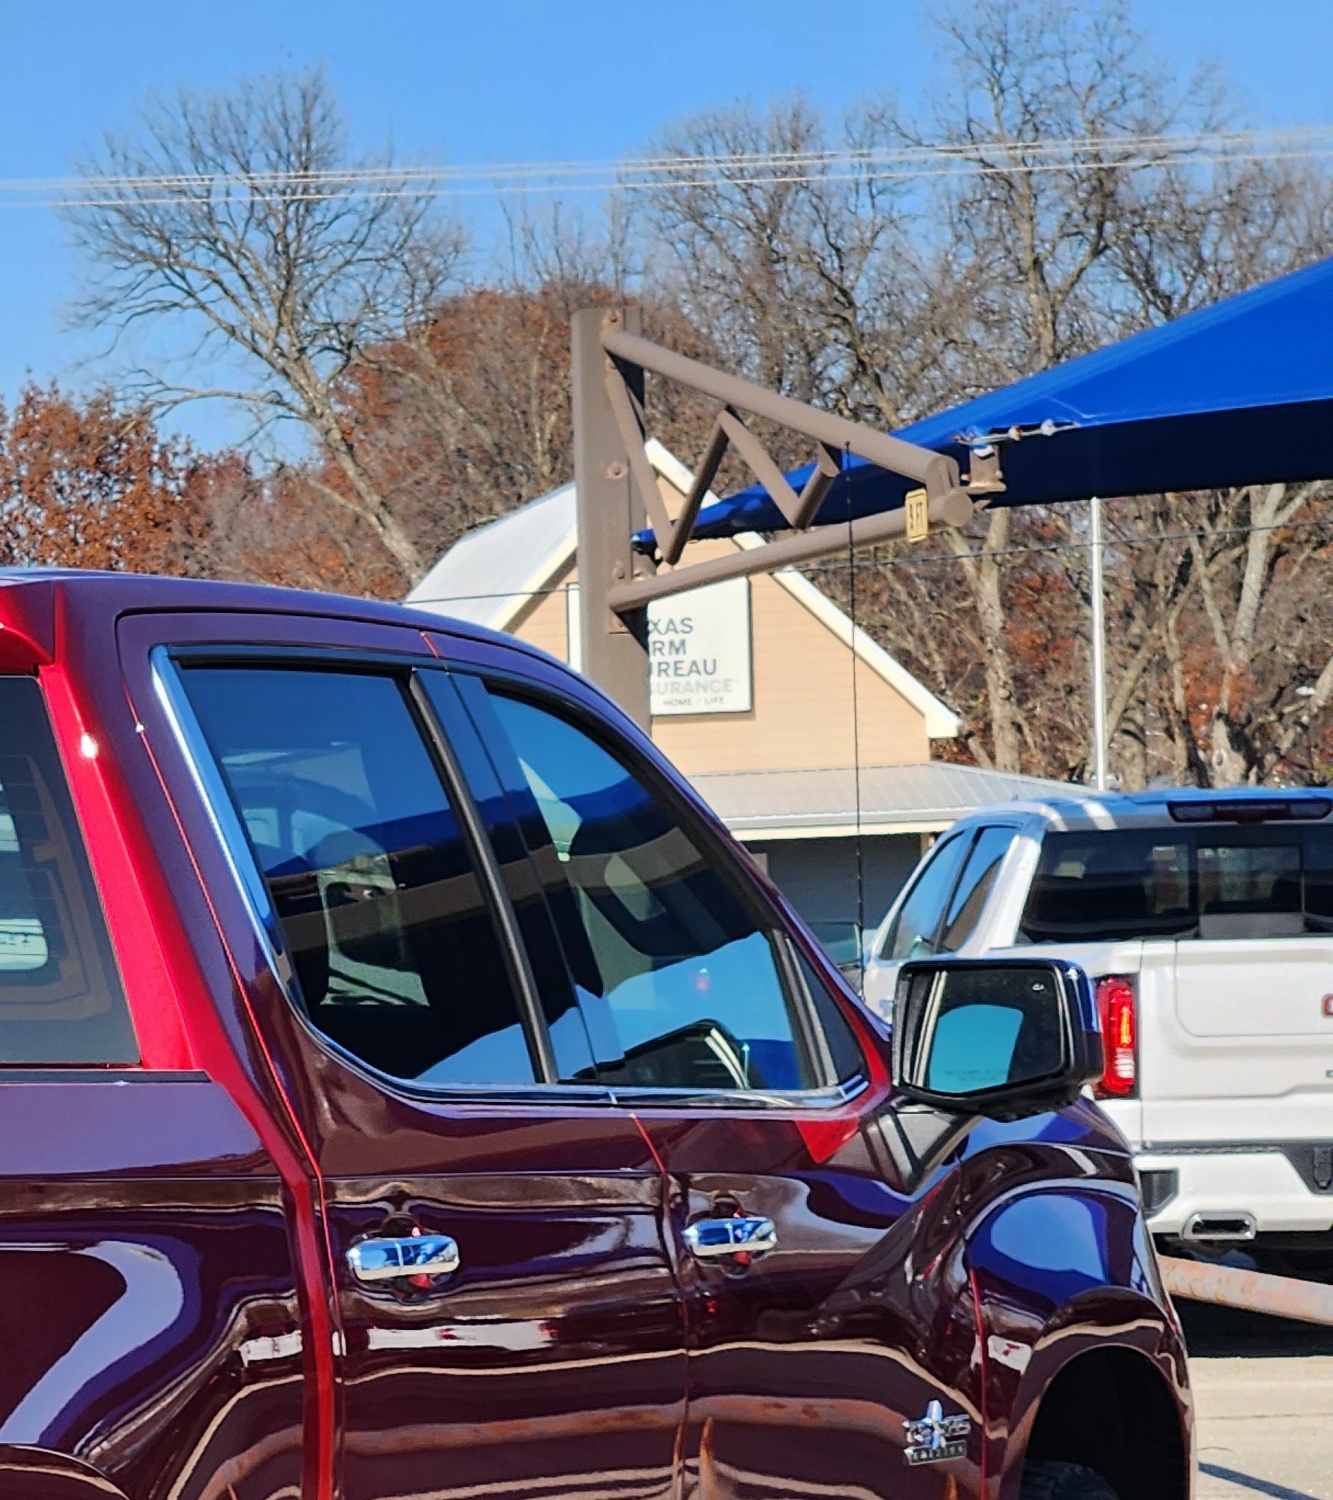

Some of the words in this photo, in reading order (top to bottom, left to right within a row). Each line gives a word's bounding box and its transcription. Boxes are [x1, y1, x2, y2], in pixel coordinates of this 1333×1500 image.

[649, 659, 717, 678] REAU
[663, 698, 693, 706] HOME
[704, 696, 724, 705] LIFE
